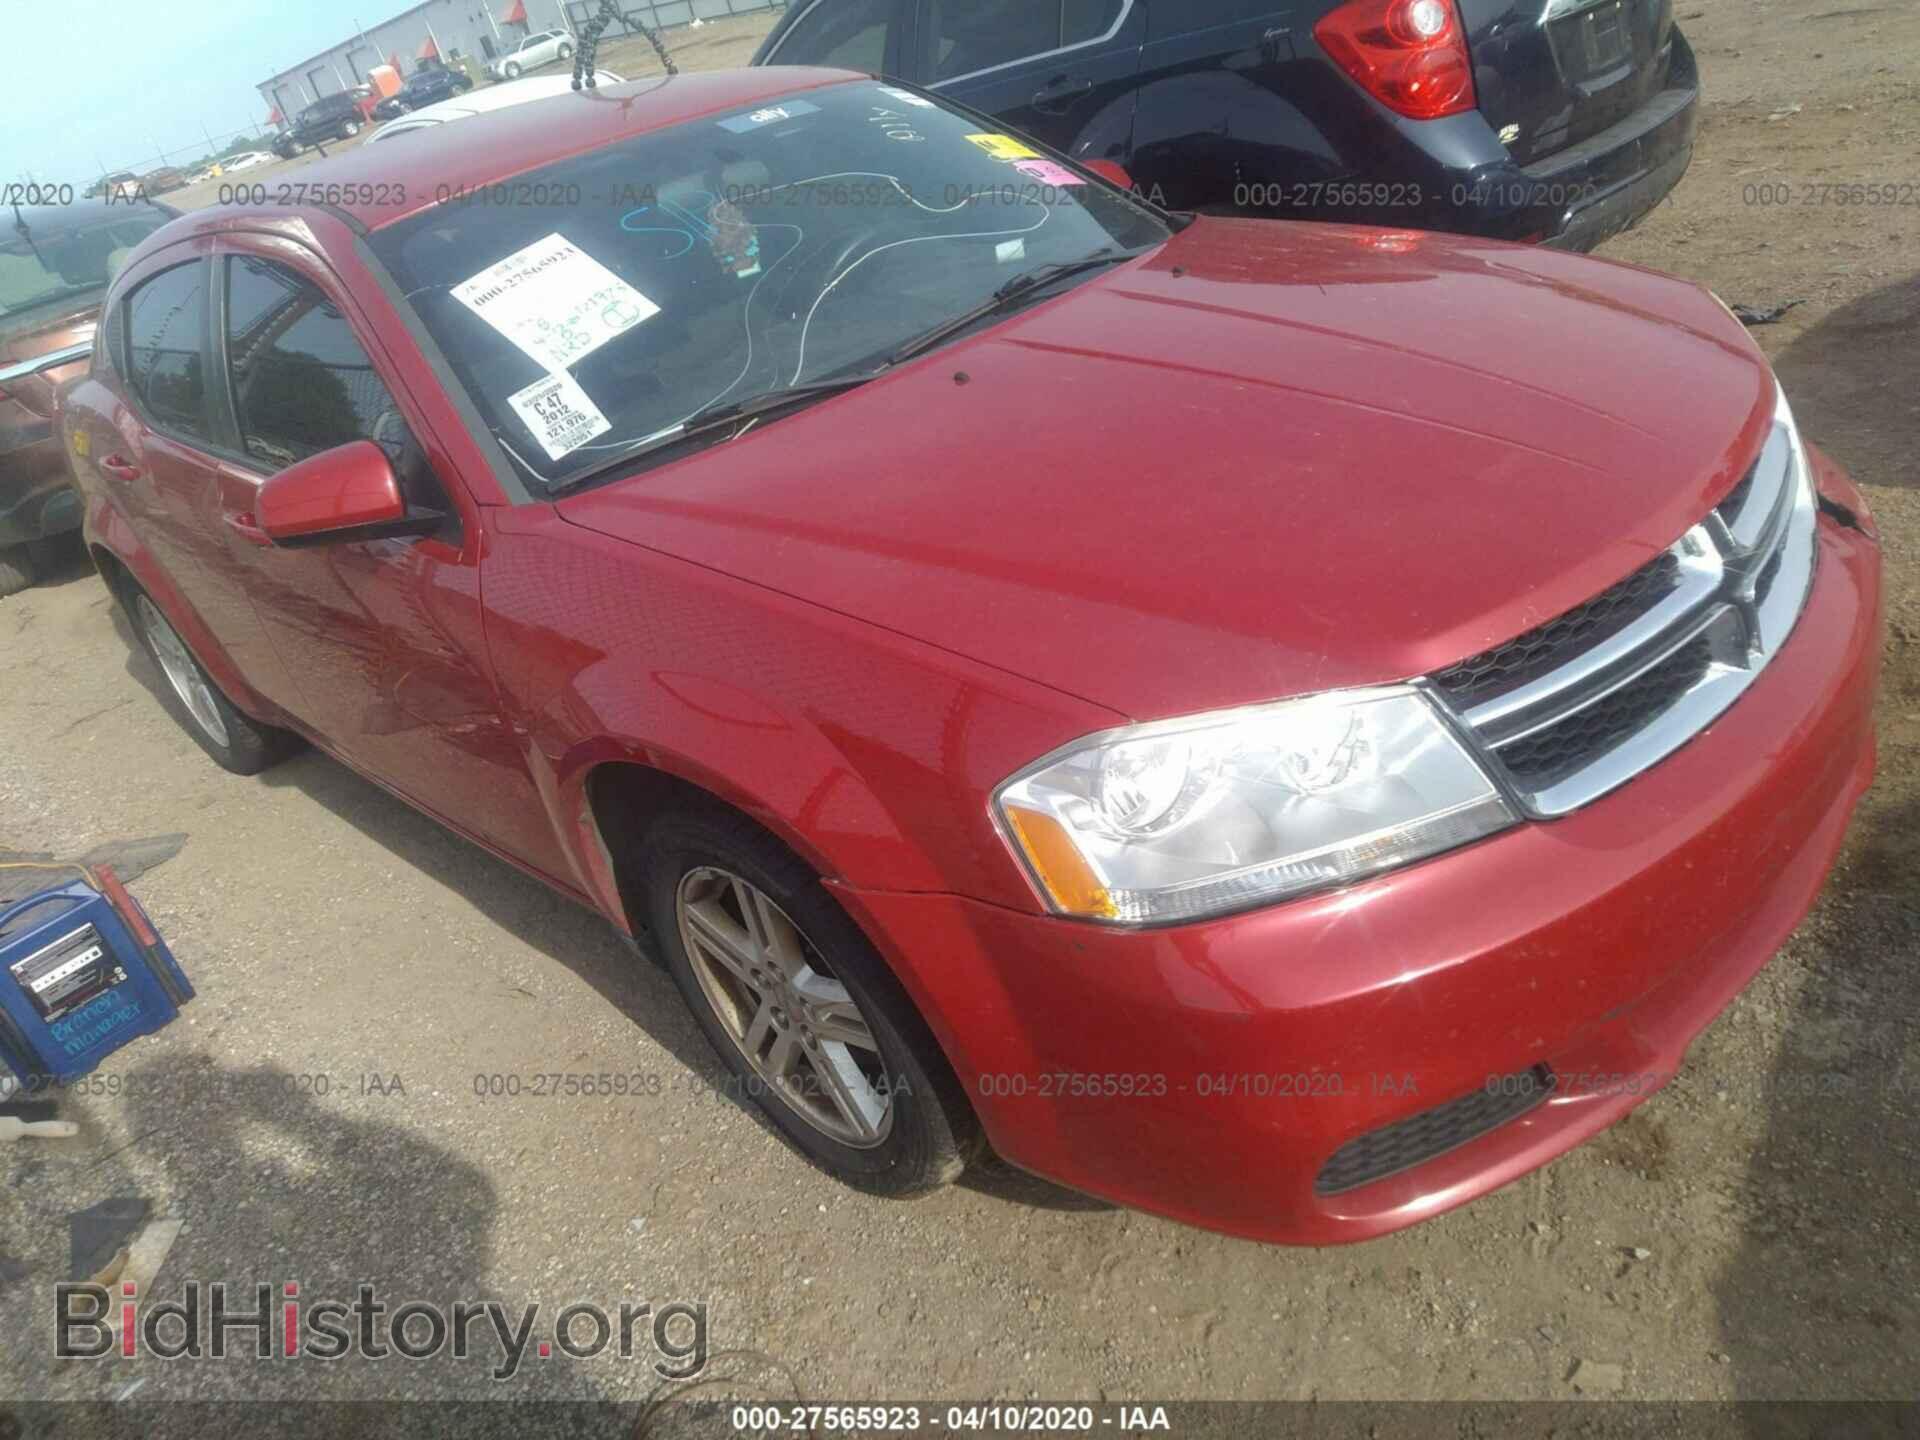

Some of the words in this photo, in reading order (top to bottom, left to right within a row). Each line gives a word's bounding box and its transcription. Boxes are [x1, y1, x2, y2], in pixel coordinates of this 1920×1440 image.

[749, 107, 789, 122] ally
[533, 402, 546, 416] C
[546, 392, 562, 408] 47
[542, 404, 570, 425] 2012
